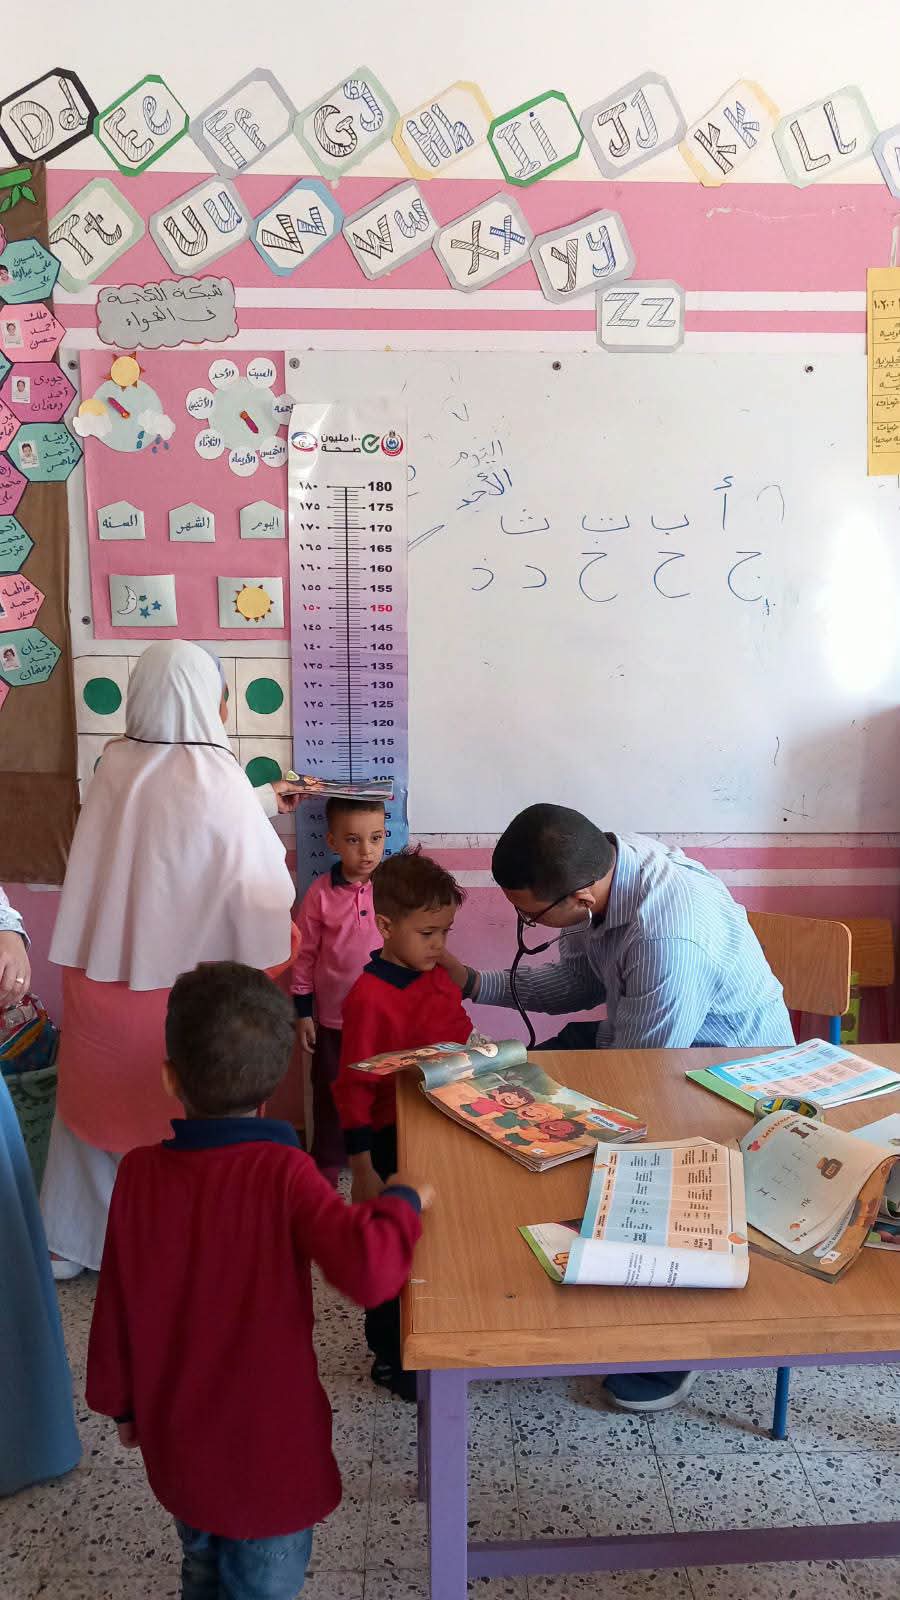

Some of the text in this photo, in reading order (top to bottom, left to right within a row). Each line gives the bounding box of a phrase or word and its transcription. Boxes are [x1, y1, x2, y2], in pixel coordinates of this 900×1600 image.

[9, 77, 88, 153] Dd
[102, 95, 172, 163] Ee
[204, 107, 266, 169] Ff
[406, 103, 475, 167] Hh
[497, 111, 558, 178] Ii
[49, 211, 122, 266] Tt
[248, 368, 273, 378] السبت
[321, 445, 361, 453] صحة
[299, 482, 318, 490] ١٨٠
[368, 482, 392, 491] 180
[300, 502, 320, 510] ١٧٥
[368, 503, 394, 511] 175
[369, 524, 392, 532] 170
[369, 565, 393, 573] 160
[370, 624, 393, 632] 145
[370, 643, 393, 651] 140
